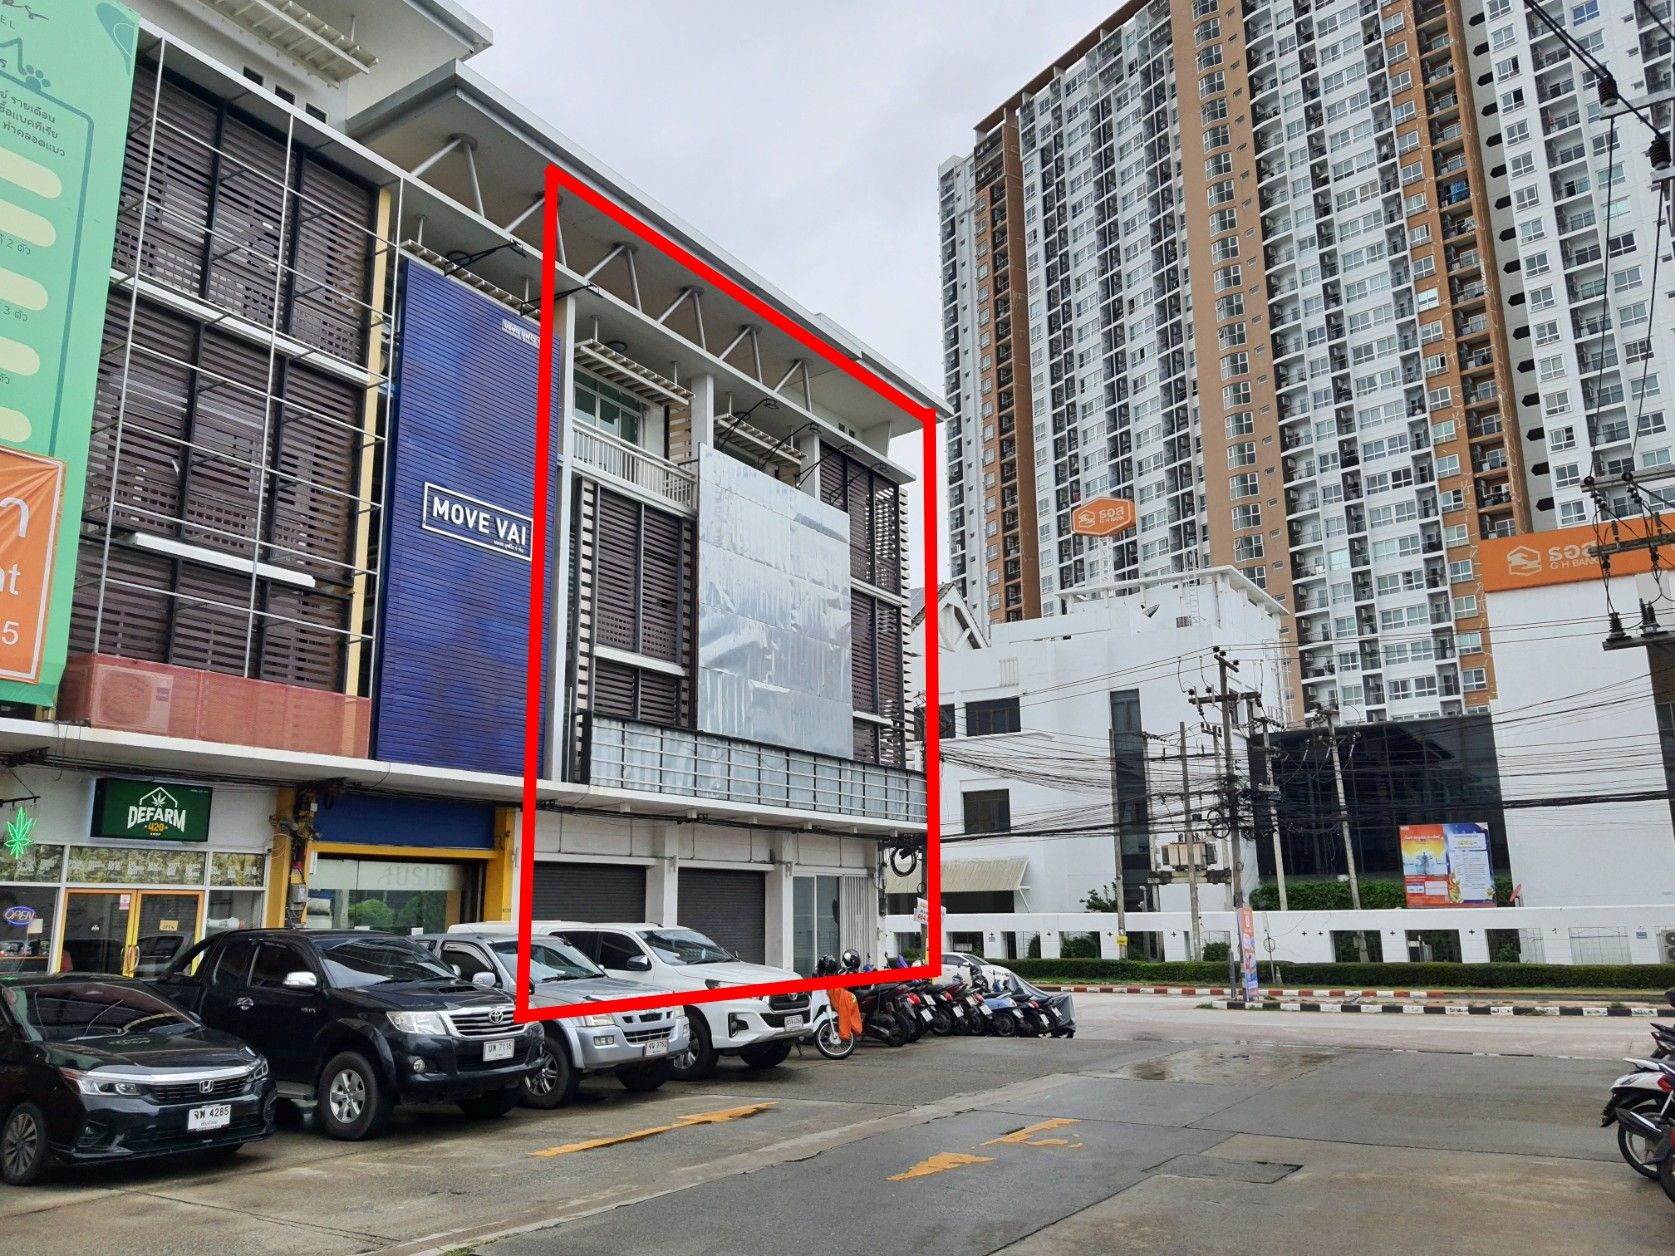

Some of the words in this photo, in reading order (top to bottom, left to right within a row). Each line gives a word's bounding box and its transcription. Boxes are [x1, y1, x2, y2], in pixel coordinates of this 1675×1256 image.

[432, 496, 491, 534] MOVE
[495, 517, 527, 546] VAI
[127, 805, 187, 833] DEFARM
[147, 822, 166, 833] 420
[5, 910, 35, 920] OPEN
